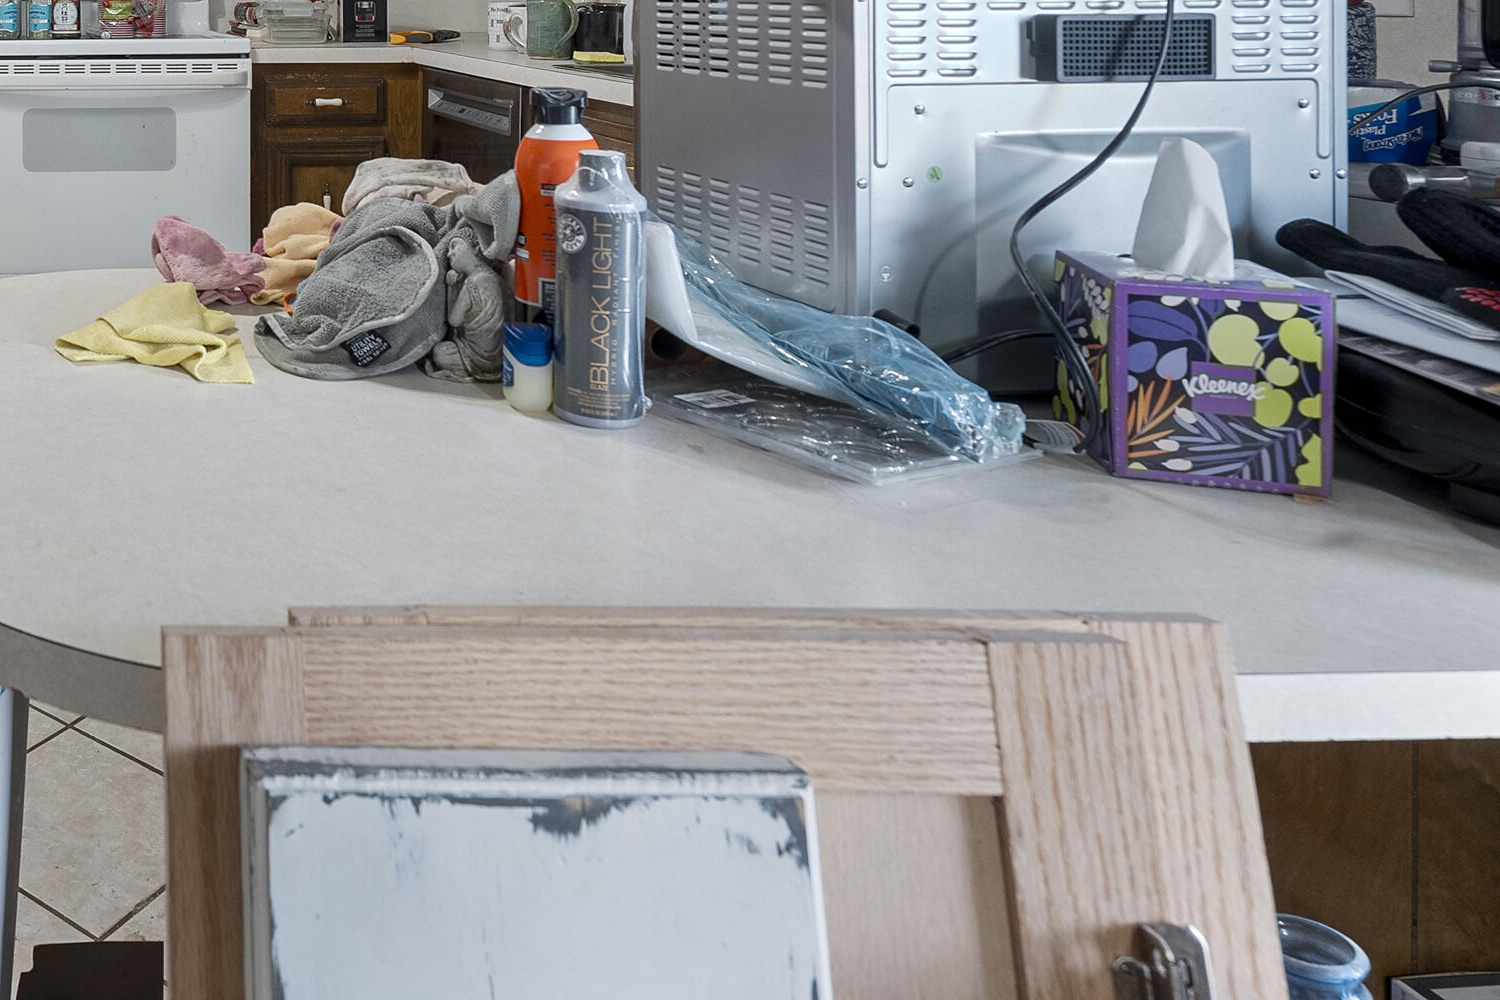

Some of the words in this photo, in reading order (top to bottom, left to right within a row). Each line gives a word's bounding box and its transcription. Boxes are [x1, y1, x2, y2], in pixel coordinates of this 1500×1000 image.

[592, 216, 613, 290] LIGHT
[611, 272, 619, 326] RADIANT
[590, 296, 611, 385] BLACK
[610, 338, 618, 385] HYBRID
[1181, 373, 1266, 401] Kleenex
